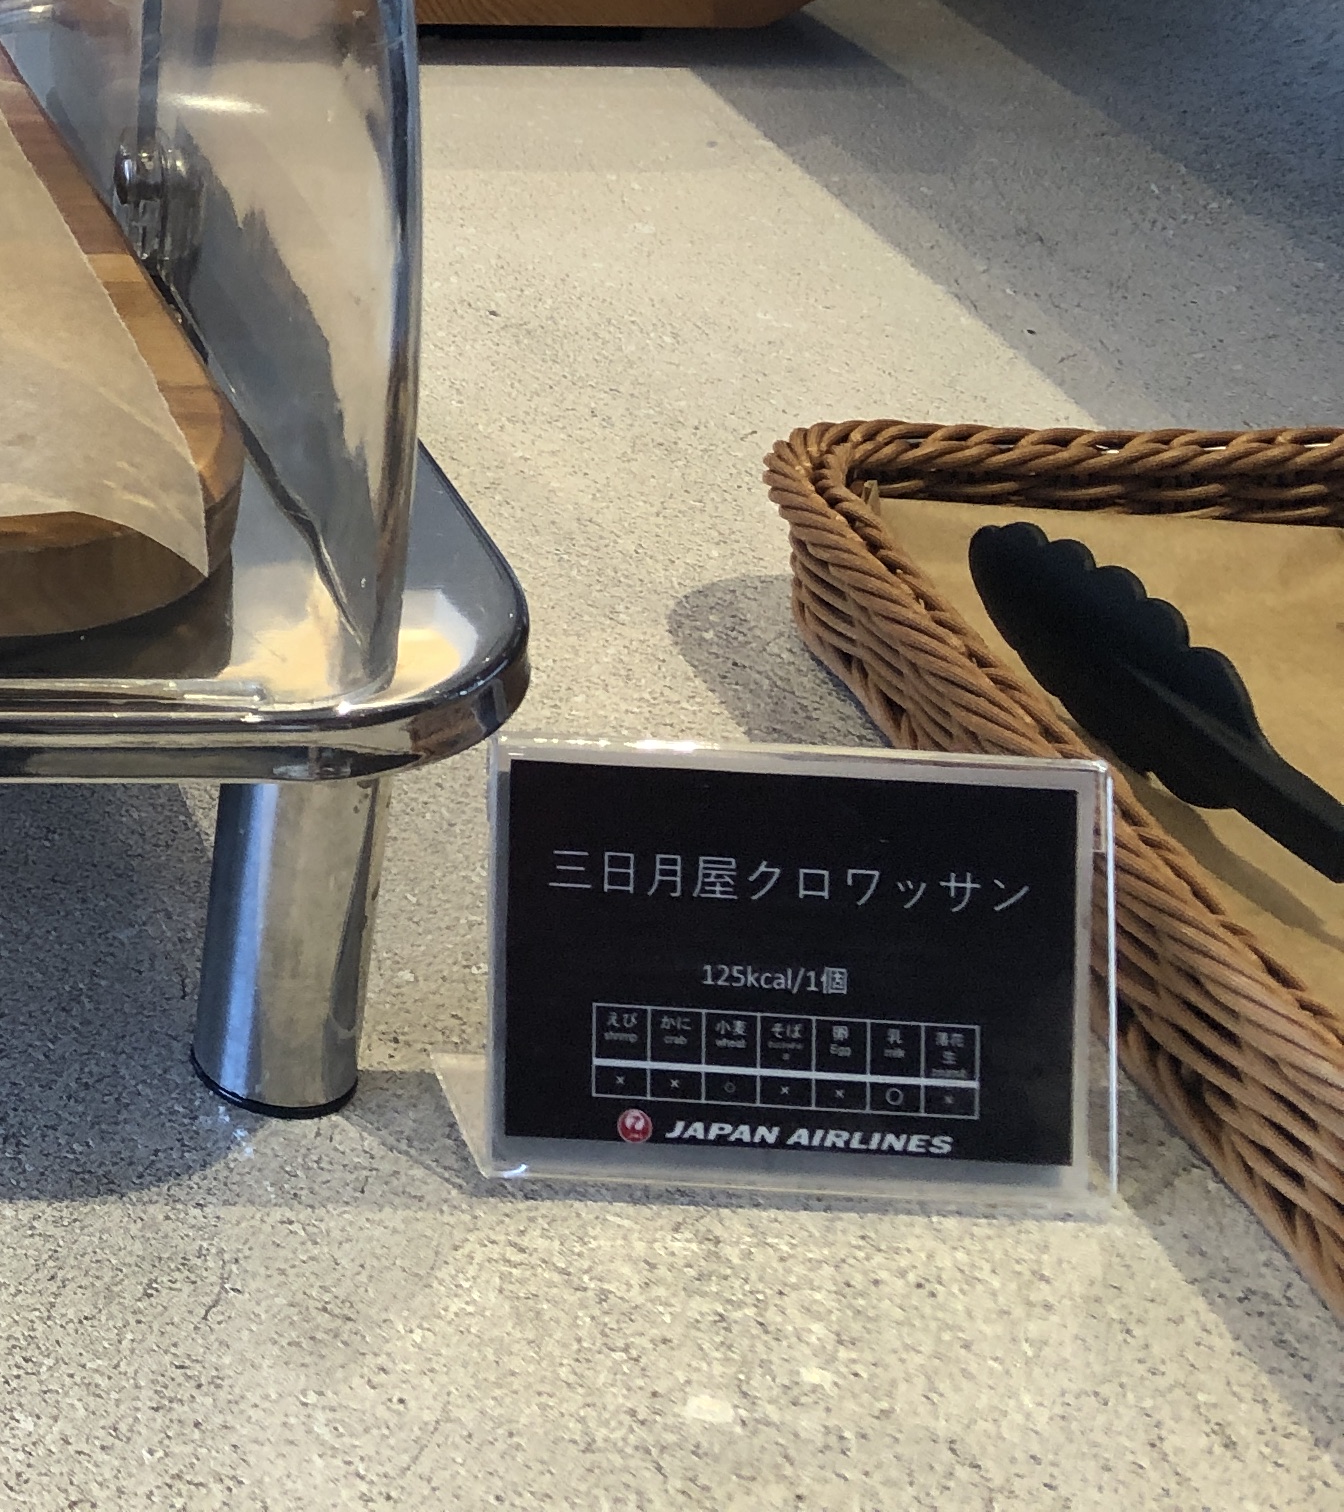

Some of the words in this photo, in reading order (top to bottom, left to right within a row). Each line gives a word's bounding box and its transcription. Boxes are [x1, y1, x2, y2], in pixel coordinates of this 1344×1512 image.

[548, 849, 1030, 912] 三日月屋クロワッサン
[701, 963, 849, 995] 125kcal/1個
[605, 1011, 639, 1028] えび
[660, 1015, 692, 1030] かに
[714, 1019, 748, 1036] 小麦
[664, 1120, 781, 1145] JAPAN
[786, 1128, 955, 1155] AIRLINES
